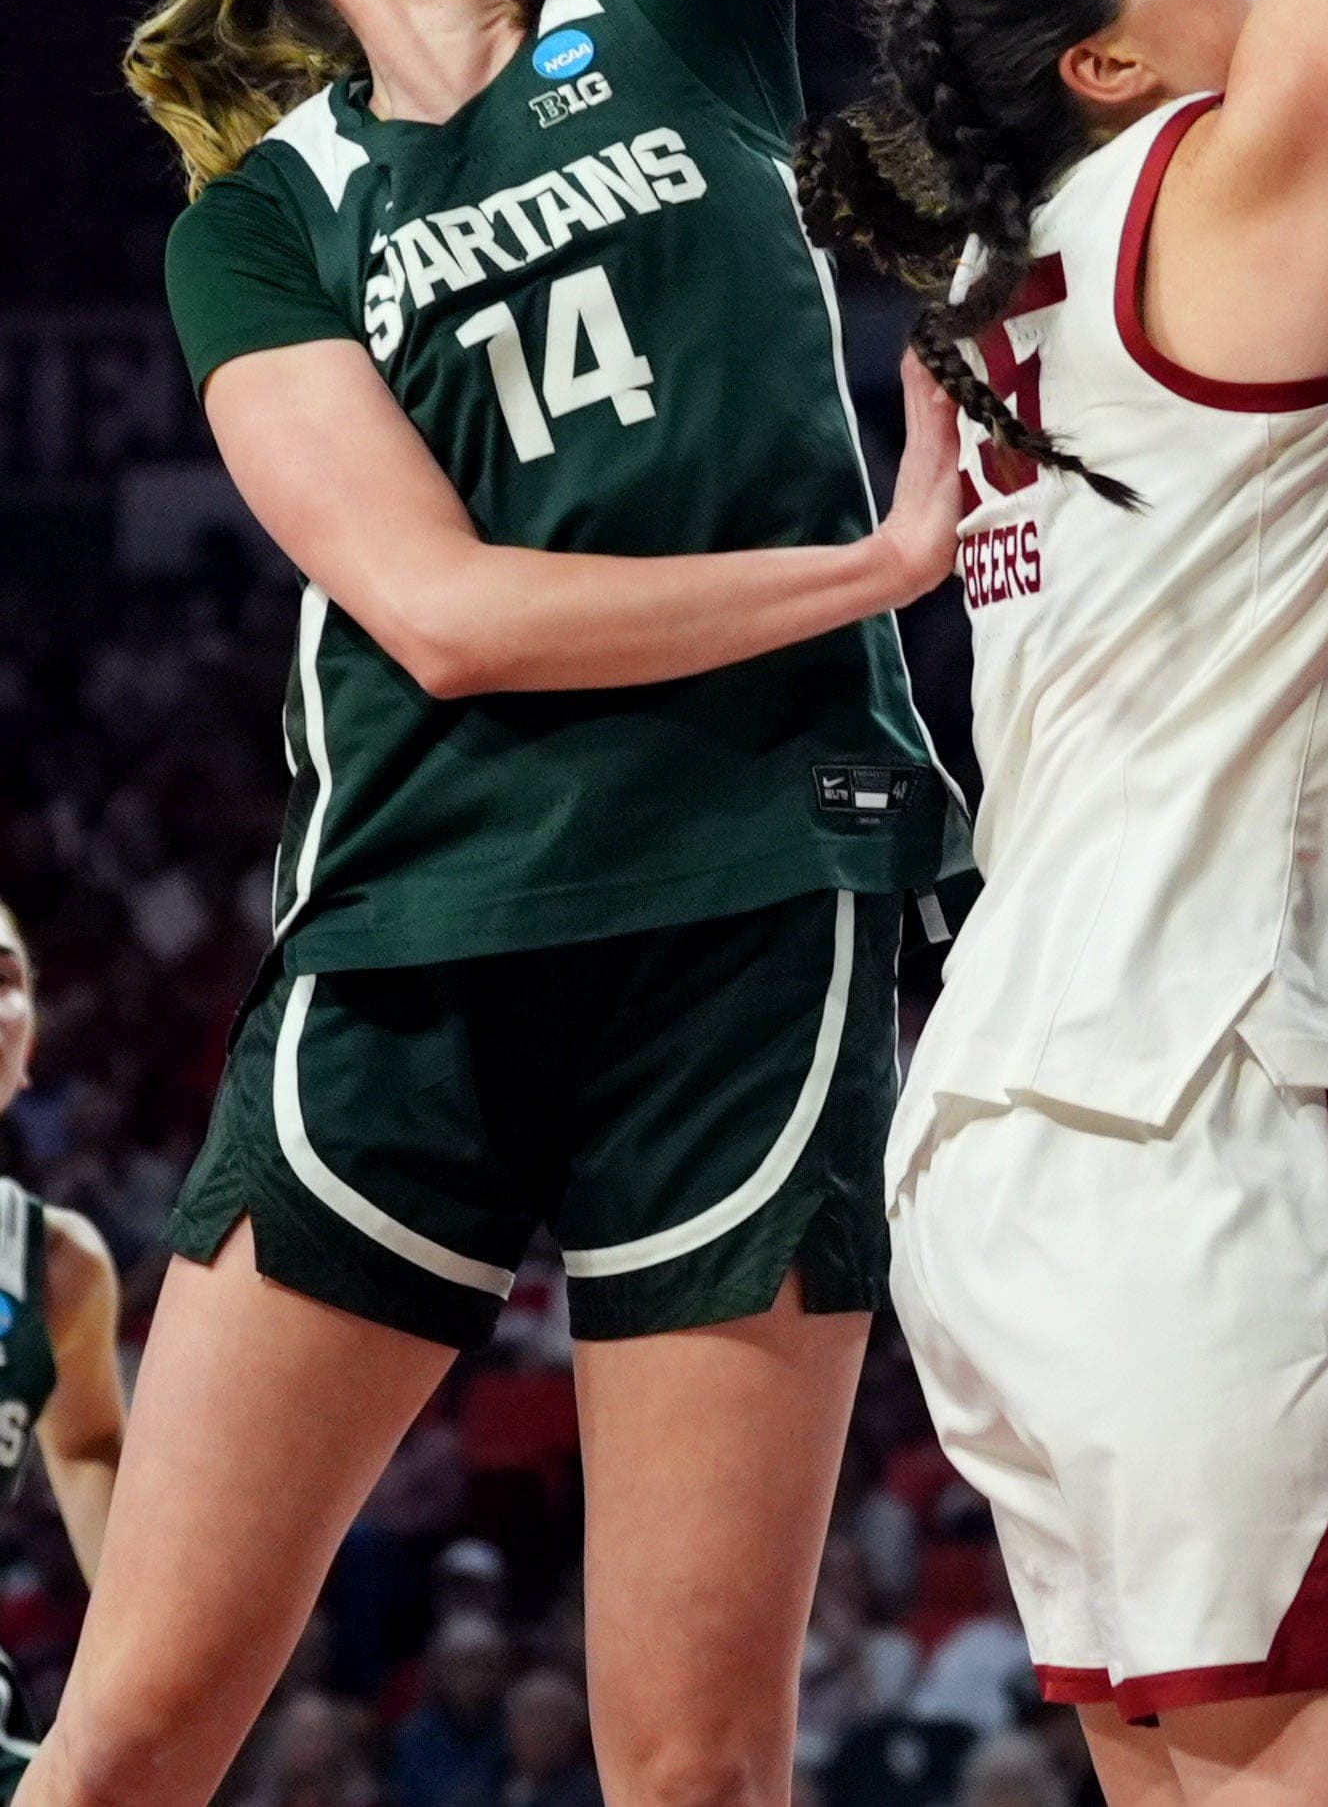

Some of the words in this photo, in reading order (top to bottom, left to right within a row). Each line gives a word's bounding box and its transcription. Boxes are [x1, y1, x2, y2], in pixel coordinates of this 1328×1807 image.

[543, 42, 592, 74] NCAA
[455, 265, 657, 464] 14
[964, 520, 1041, 609] BEERS
